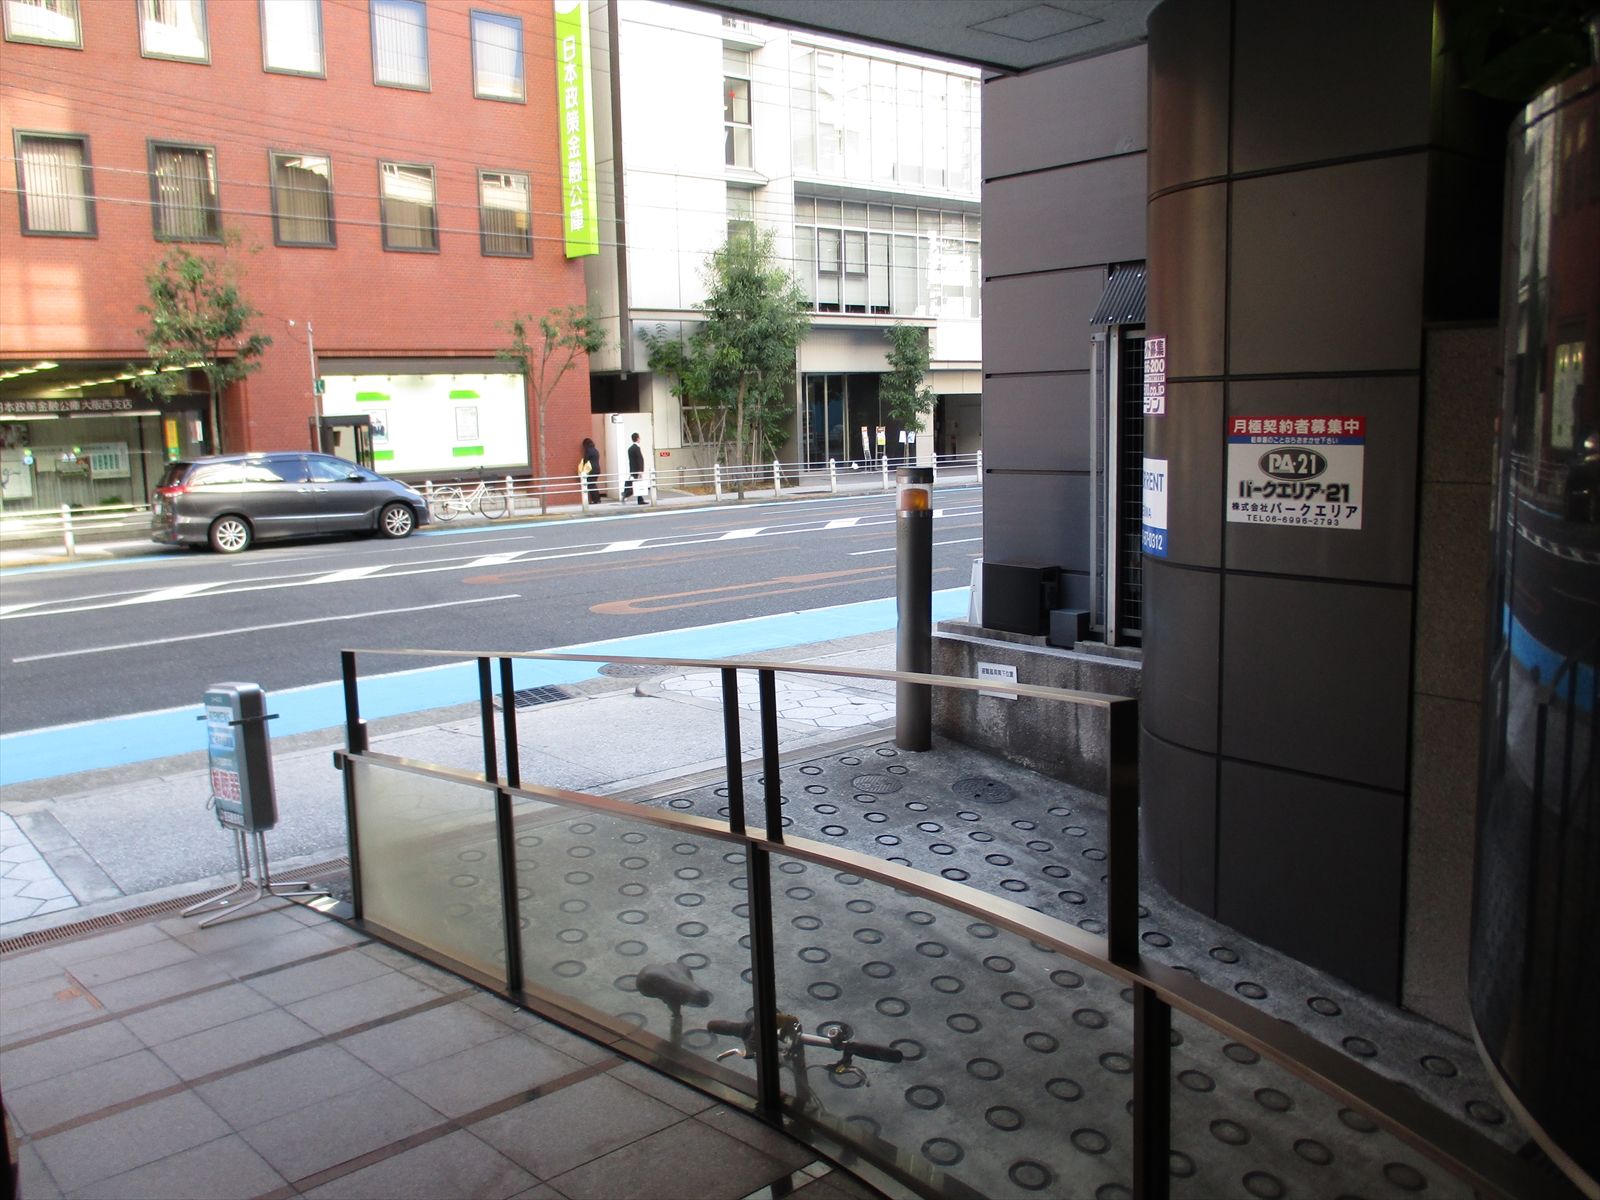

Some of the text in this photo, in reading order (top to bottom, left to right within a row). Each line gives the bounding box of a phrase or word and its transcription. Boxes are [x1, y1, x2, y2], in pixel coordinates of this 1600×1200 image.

[563, 37, 584, 232] 日本政策金融公庫
[82, 400, 132, 410] 大阪西支店
[1234, 419, 1360, 434] 月極契約者募集中
[1232, 502, 1358, 519] 株式会社パークエリア
